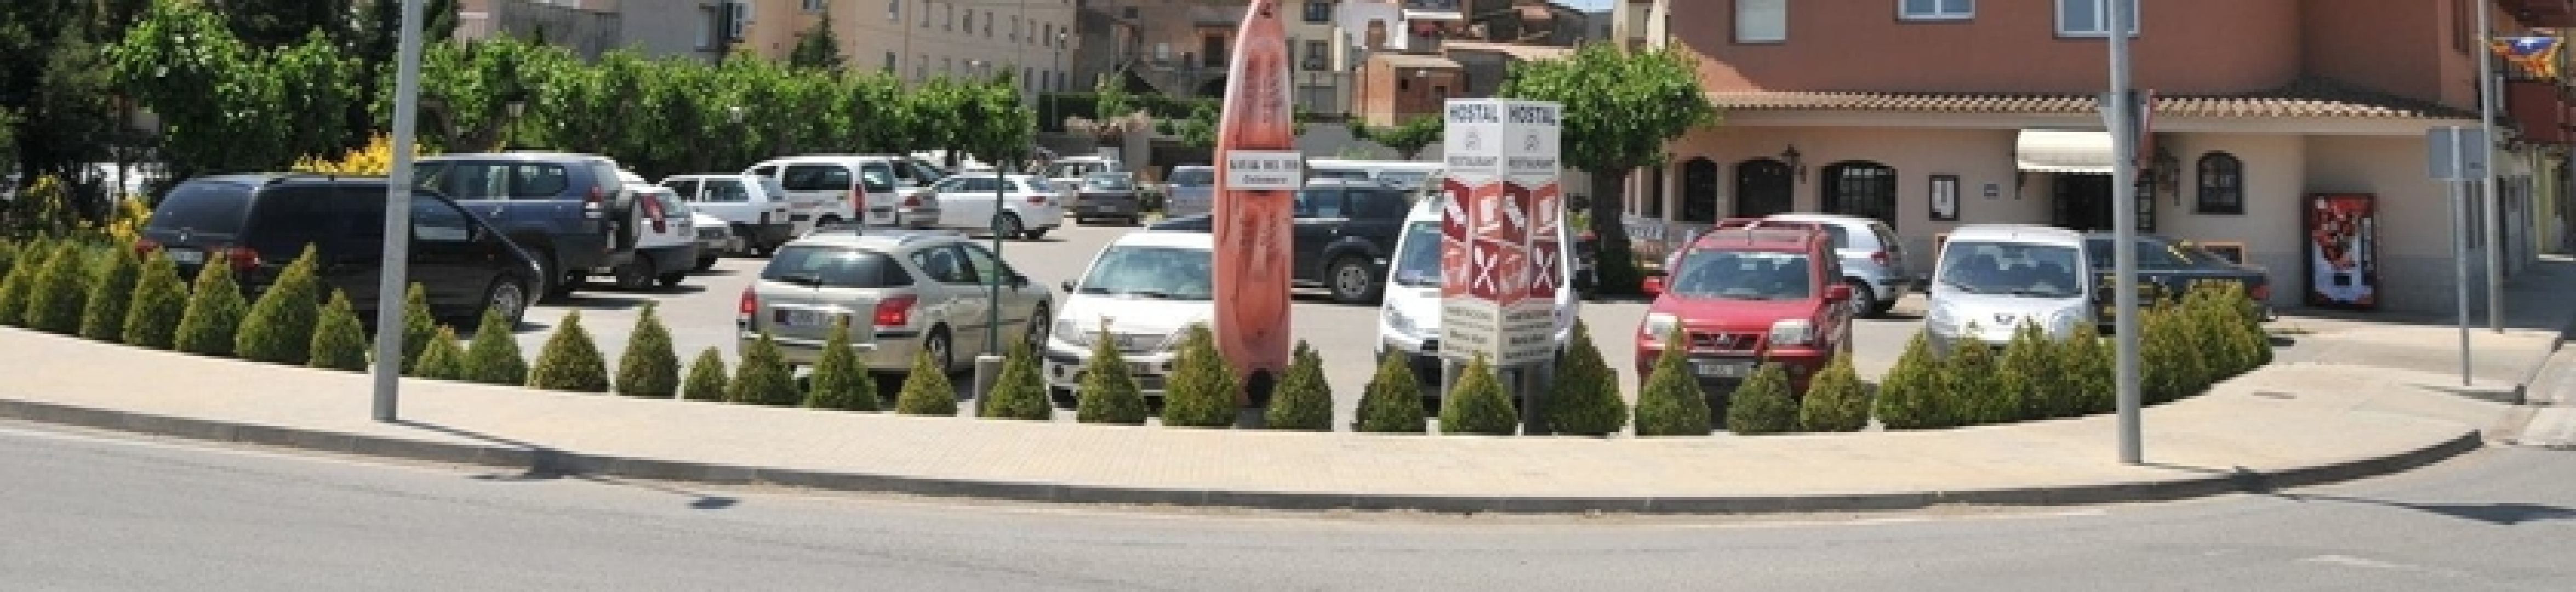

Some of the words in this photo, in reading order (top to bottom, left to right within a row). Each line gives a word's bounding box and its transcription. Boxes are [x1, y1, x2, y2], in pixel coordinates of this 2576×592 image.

[1450, 104, 1499, 123] HOSTAL
[1509, 105, 1556, 125] HOSTAL
[1448, 155, 1498, 166] RESTAURANT
[1508, 157, 1555, 169] RESTAURANT
